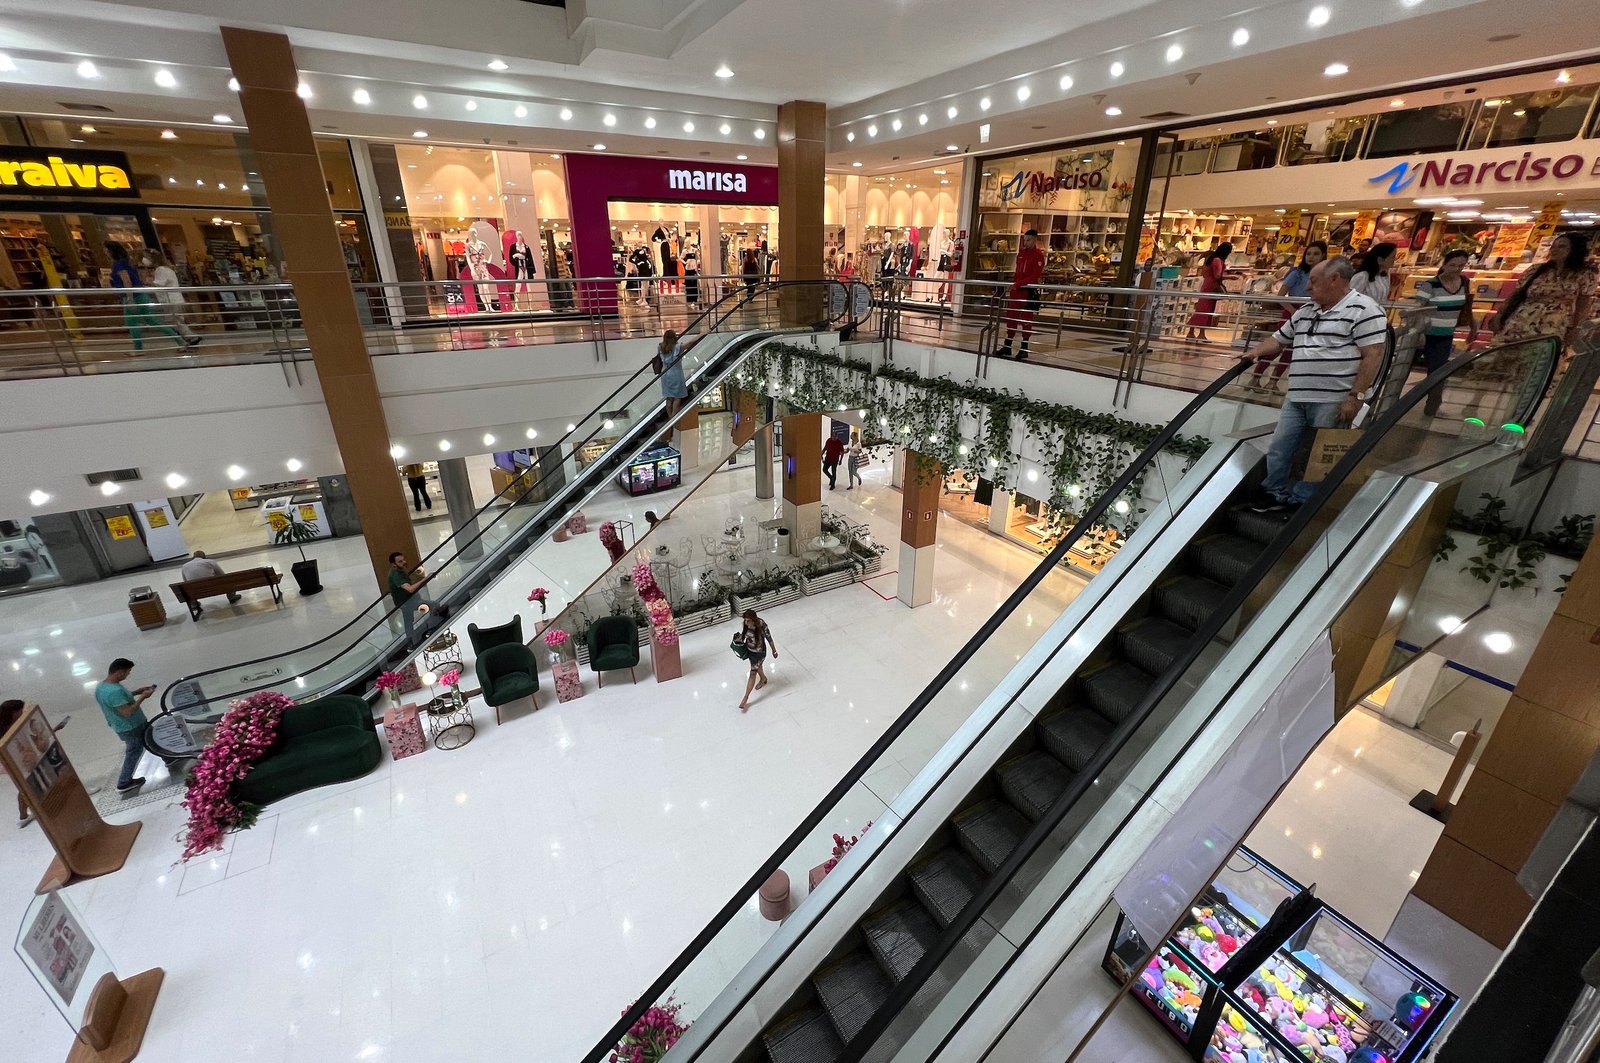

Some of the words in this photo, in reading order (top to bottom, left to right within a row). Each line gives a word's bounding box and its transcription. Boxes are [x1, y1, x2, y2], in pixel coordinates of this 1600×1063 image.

[669, 169, 747, 193] marisa
[1030, 168, 1103, 193] Narciso
[1419, 152, 1584, 188] Narciso
[1145, 989, 1188, 1033] CUBO
